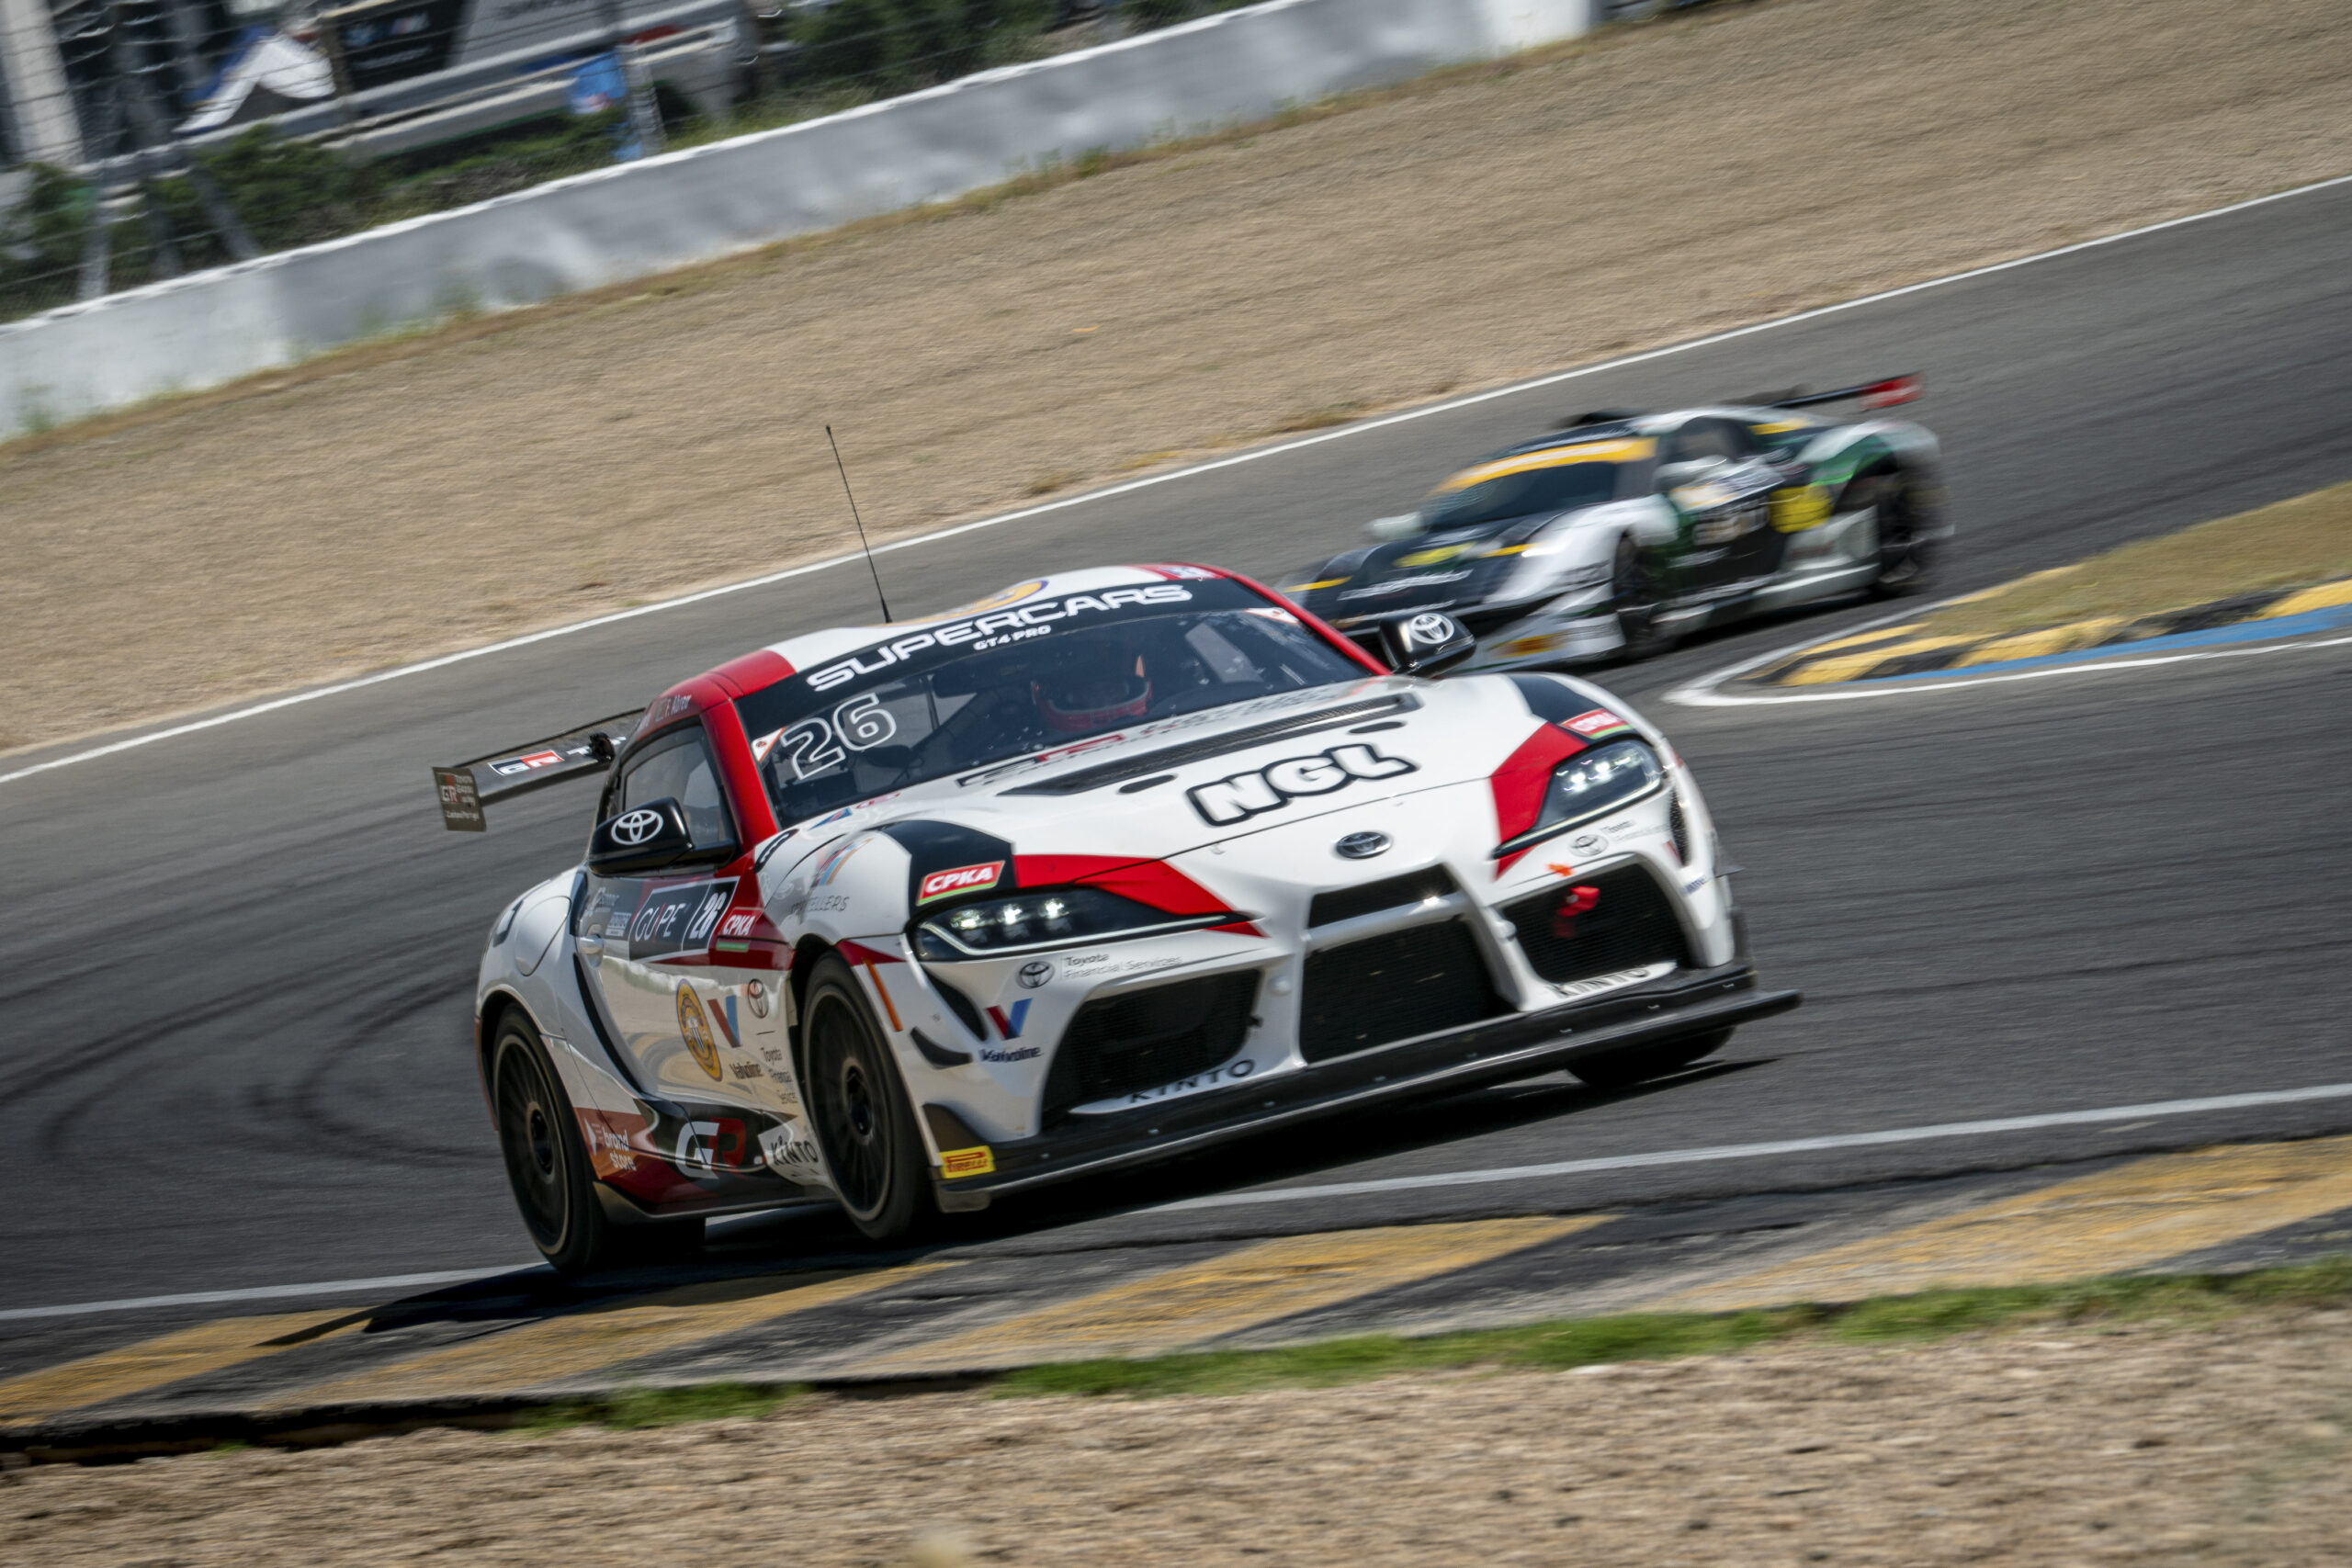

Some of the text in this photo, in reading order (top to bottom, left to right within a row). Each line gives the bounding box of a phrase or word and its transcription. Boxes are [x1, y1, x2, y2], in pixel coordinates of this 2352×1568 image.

[806, 584, 1193, 692] SUPERCARS
[973, 625, 1052, 650] GT4 PRO
[779, 692, 897, 780] 26
[1185, 743, 1421, 828] NGL
[925, 866, 994, 894] CPKA
[690, 891, 728, 940] 26
[723, 915, 756, 936] CPKA
[1065, 953, 1110, 967] Toyota
[1130, 1059, 1256, 1103] KINTO
[602, 1125, 630, 1152] brand
[675, 1116, 747, 1179] GR
[609, 1150, 638, 1172] store
